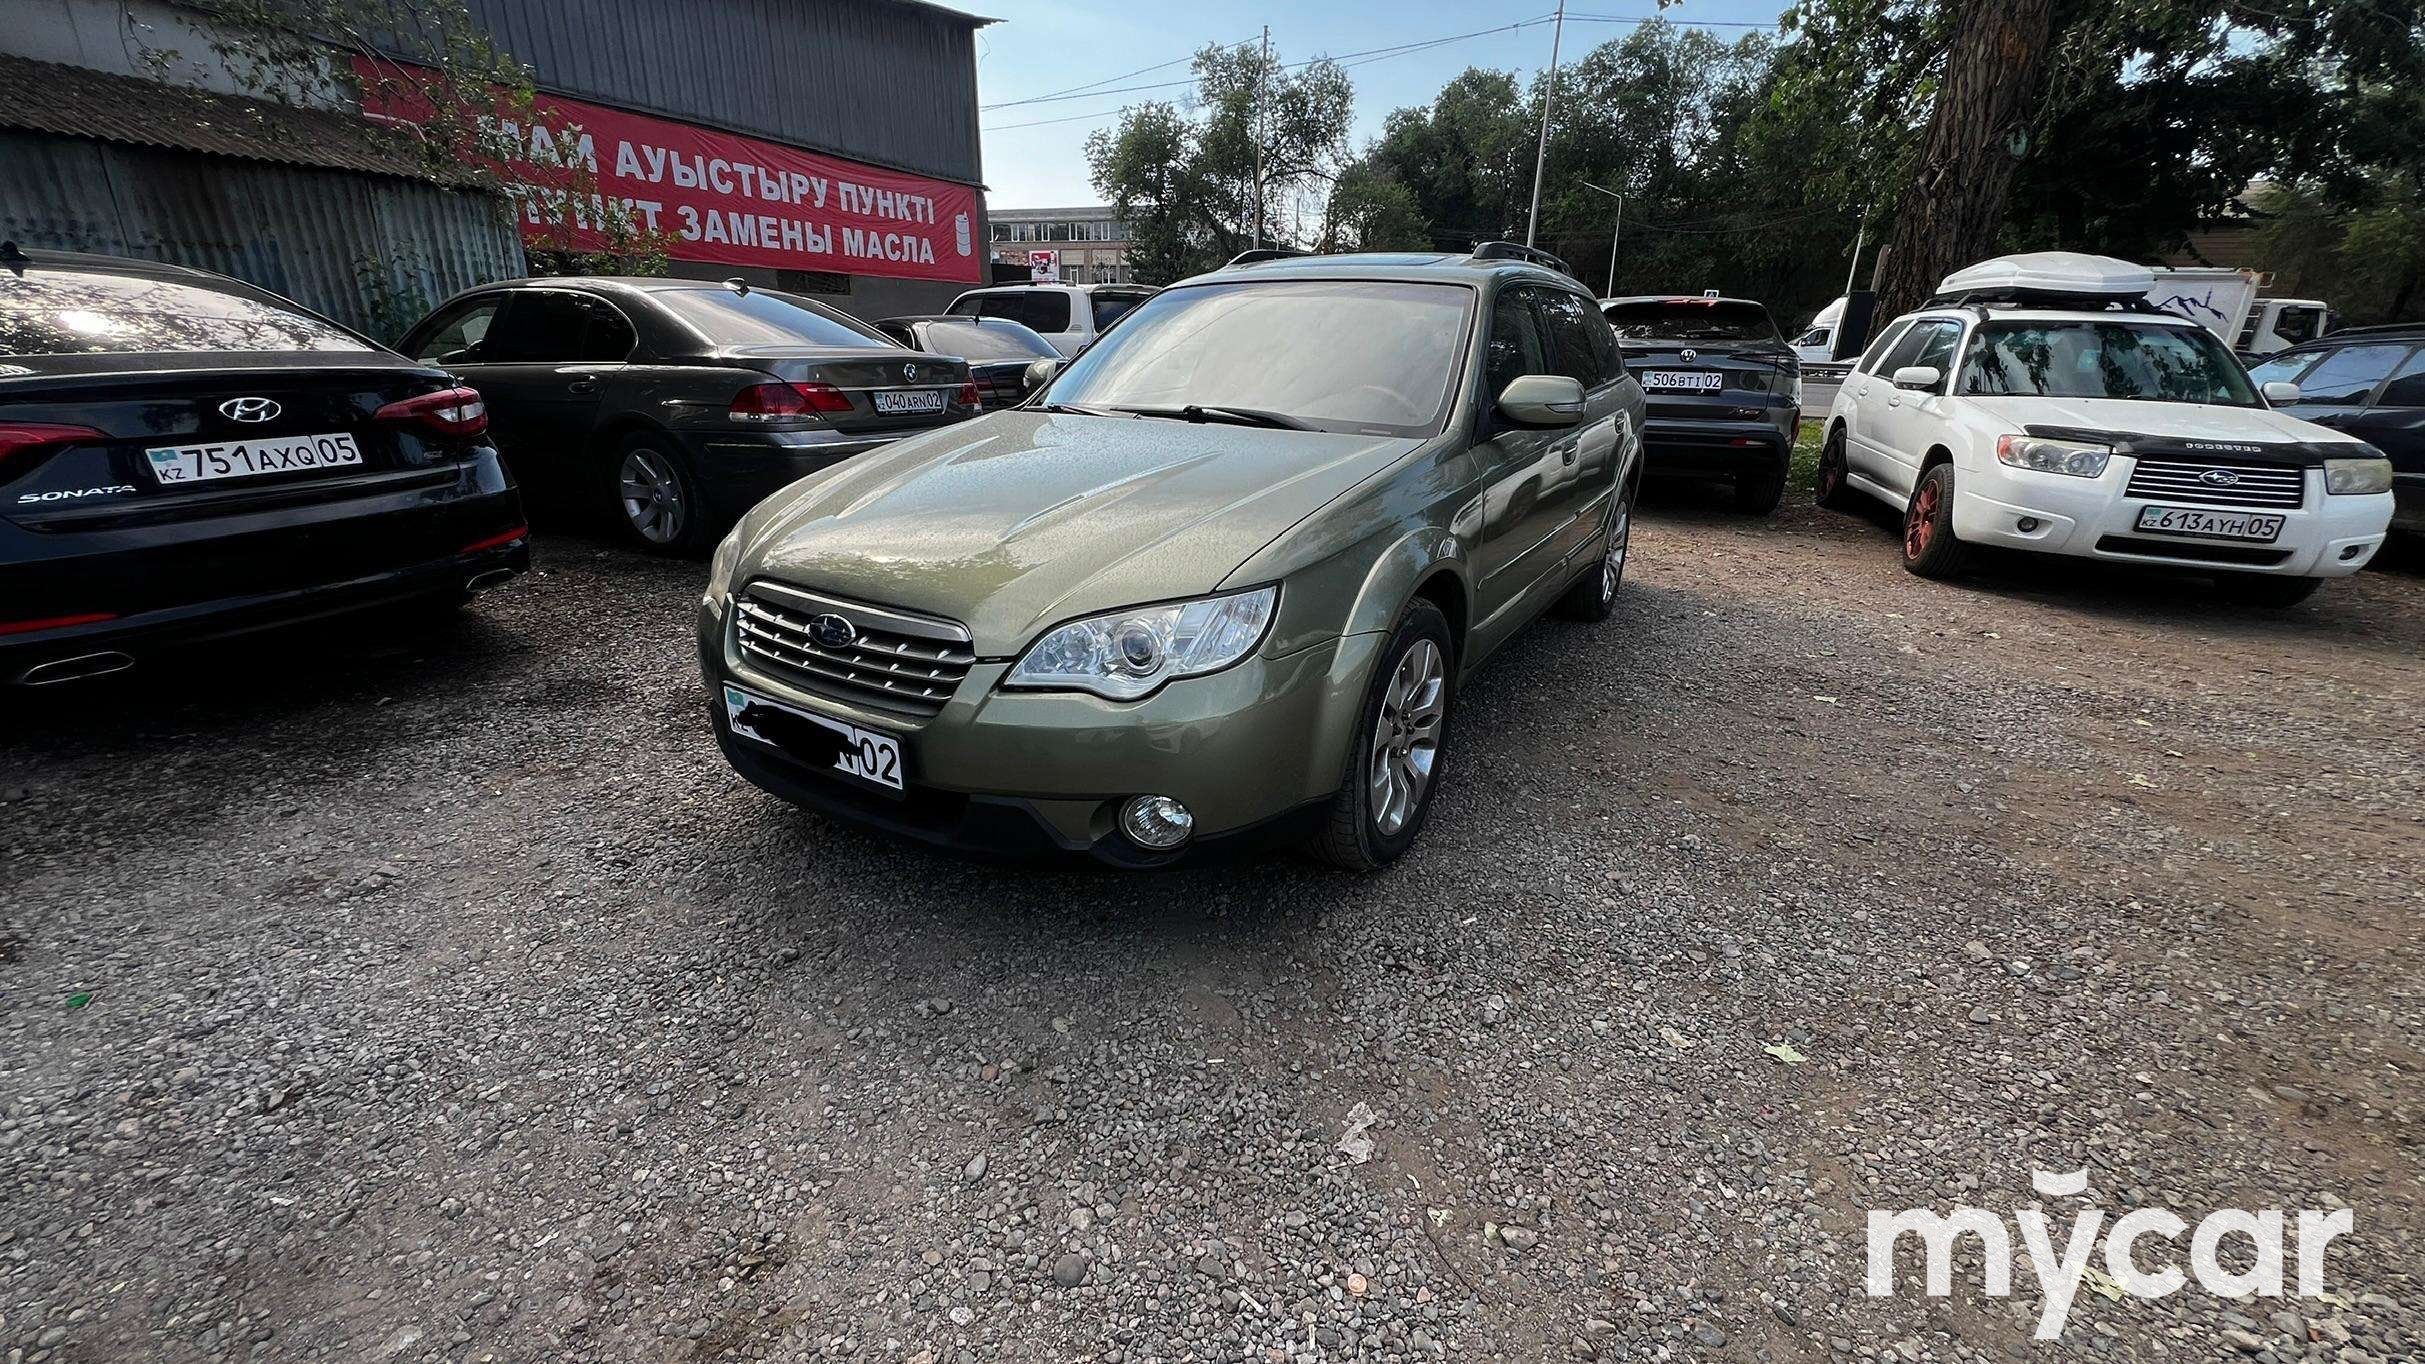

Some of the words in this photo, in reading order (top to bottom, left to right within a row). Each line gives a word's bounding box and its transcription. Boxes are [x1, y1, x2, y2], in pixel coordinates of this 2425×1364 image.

[615, 140, 828, 208] АУЫСТЫРУ
[838, 181, 935, 225] ПУНКТІ
[677, 205, 833, 254] ЗАМЕНЫ
[842, 227, 935, 264] МАСЛА
[158, 467, 187, 481] KZ
[18, 485, 137, 504] SONATA
[2141, 518, 2157, 527] KZ
[859, 737, 901, 786] 02
